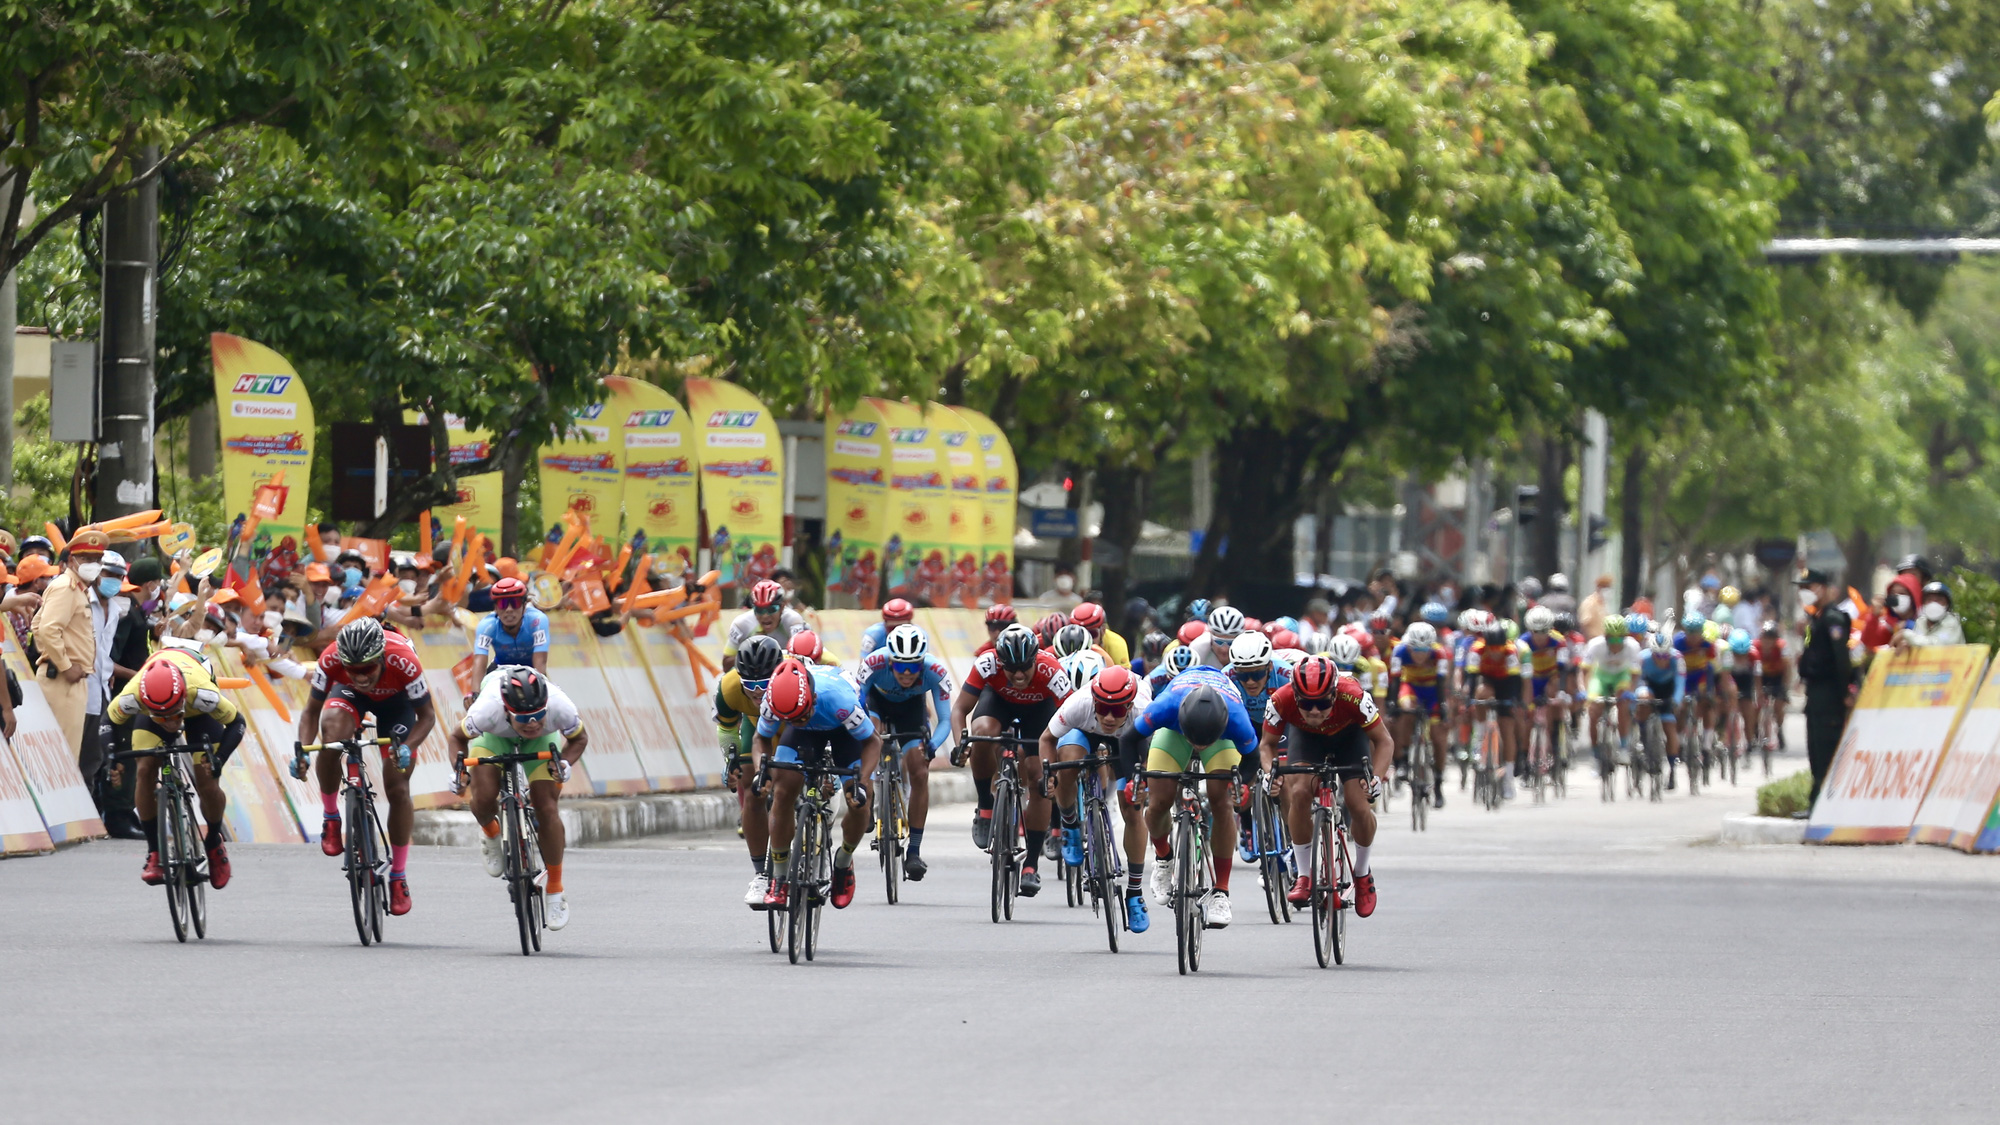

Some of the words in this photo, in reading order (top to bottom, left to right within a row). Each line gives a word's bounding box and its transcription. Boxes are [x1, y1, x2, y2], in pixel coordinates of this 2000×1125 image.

[233, 375, 290, 393] HTV
[625, 410, 674, 426] HTV
[707, 411, 759, 427] HTV
[480, 638, 491, 647] 12
[322, 652, 340, 668] GS
[387, 653, 417, 677] GSB
[980, 657, 991, 673] 72
[1038, 663, 1055, 678] GS
[410, 682, 424, 694] 71
[797, 671, 806, 706] RUDY
[1053, 676, 1068, 691] 72
[850, 714, 862, 726] 11
[1842, 750, 1887, 799] TON
[1868, 750, 1923, 799] DONG
